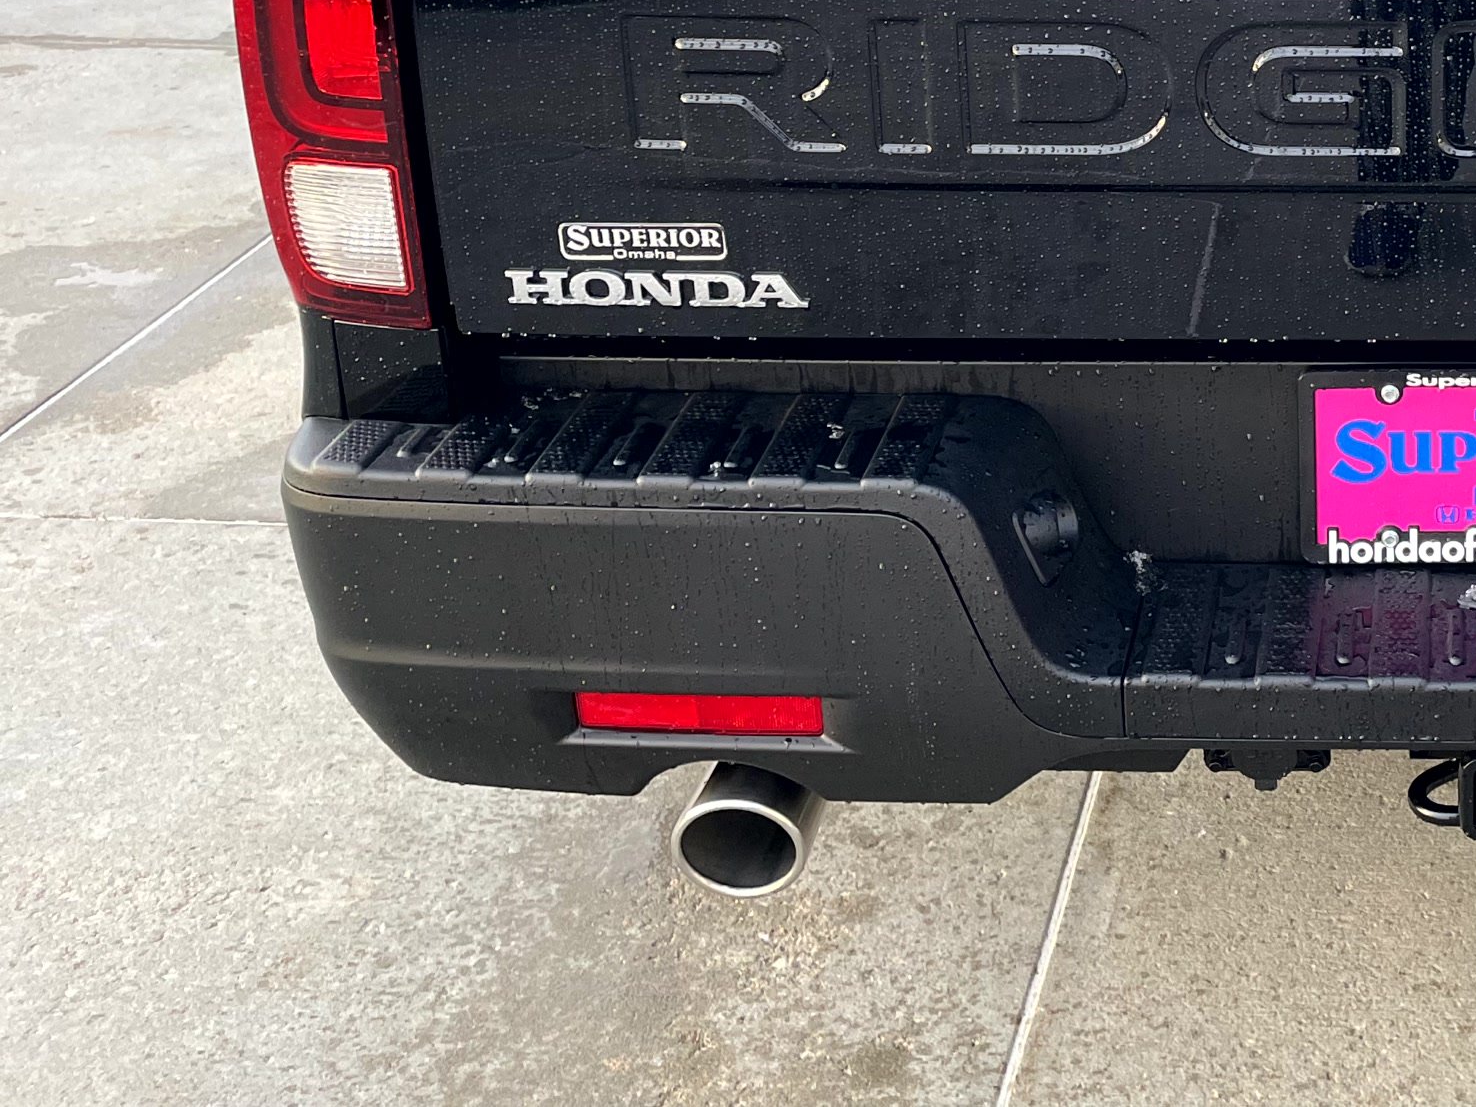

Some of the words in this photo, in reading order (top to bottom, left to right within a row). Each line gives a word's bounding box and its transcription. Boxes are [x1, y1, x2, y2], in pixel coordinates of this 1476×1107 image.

[566, 224, 722, 251] SUPERIOR
[613, 248, 677, 260] Omaha
[504, 268, 811, 309] HONDA
